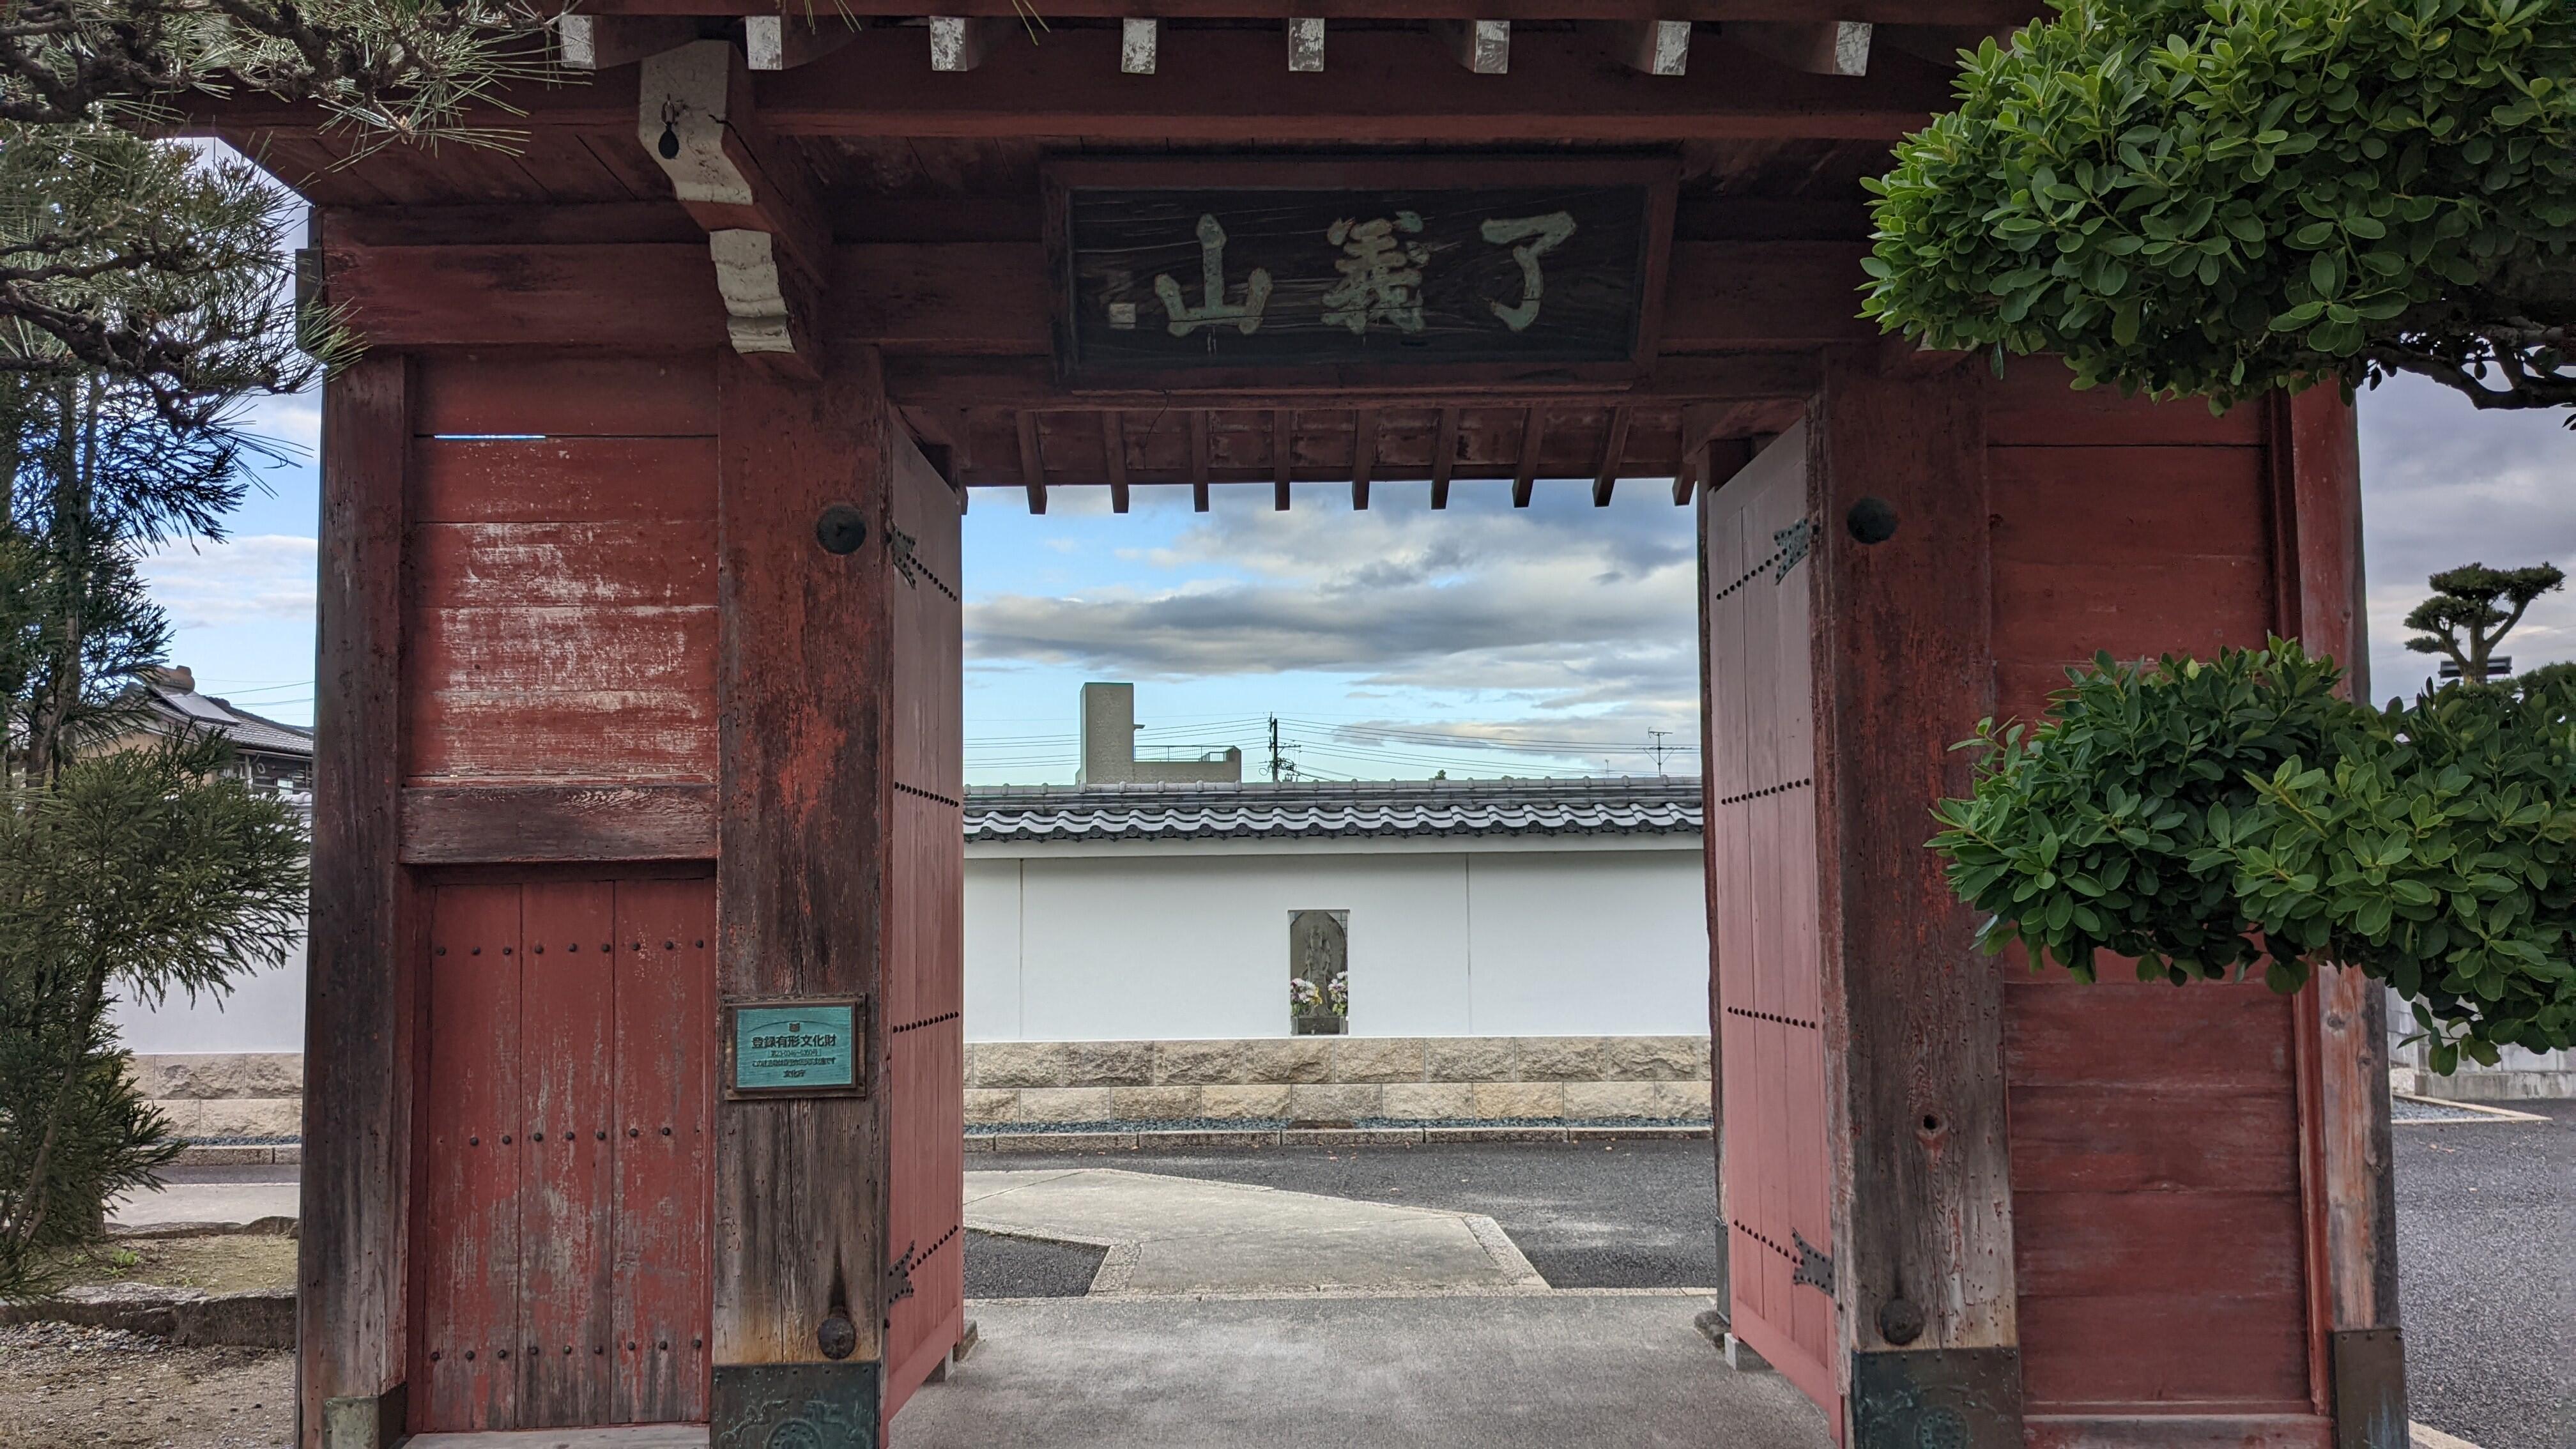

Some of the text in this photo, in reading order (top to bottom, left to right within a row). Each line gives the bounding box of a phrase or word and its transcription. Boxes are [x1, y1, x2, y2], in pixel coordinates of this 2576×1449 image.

[751, 1034, 836, 1049] 登録有形文化財
[783, 1069, 806, 1078] 文化庁
